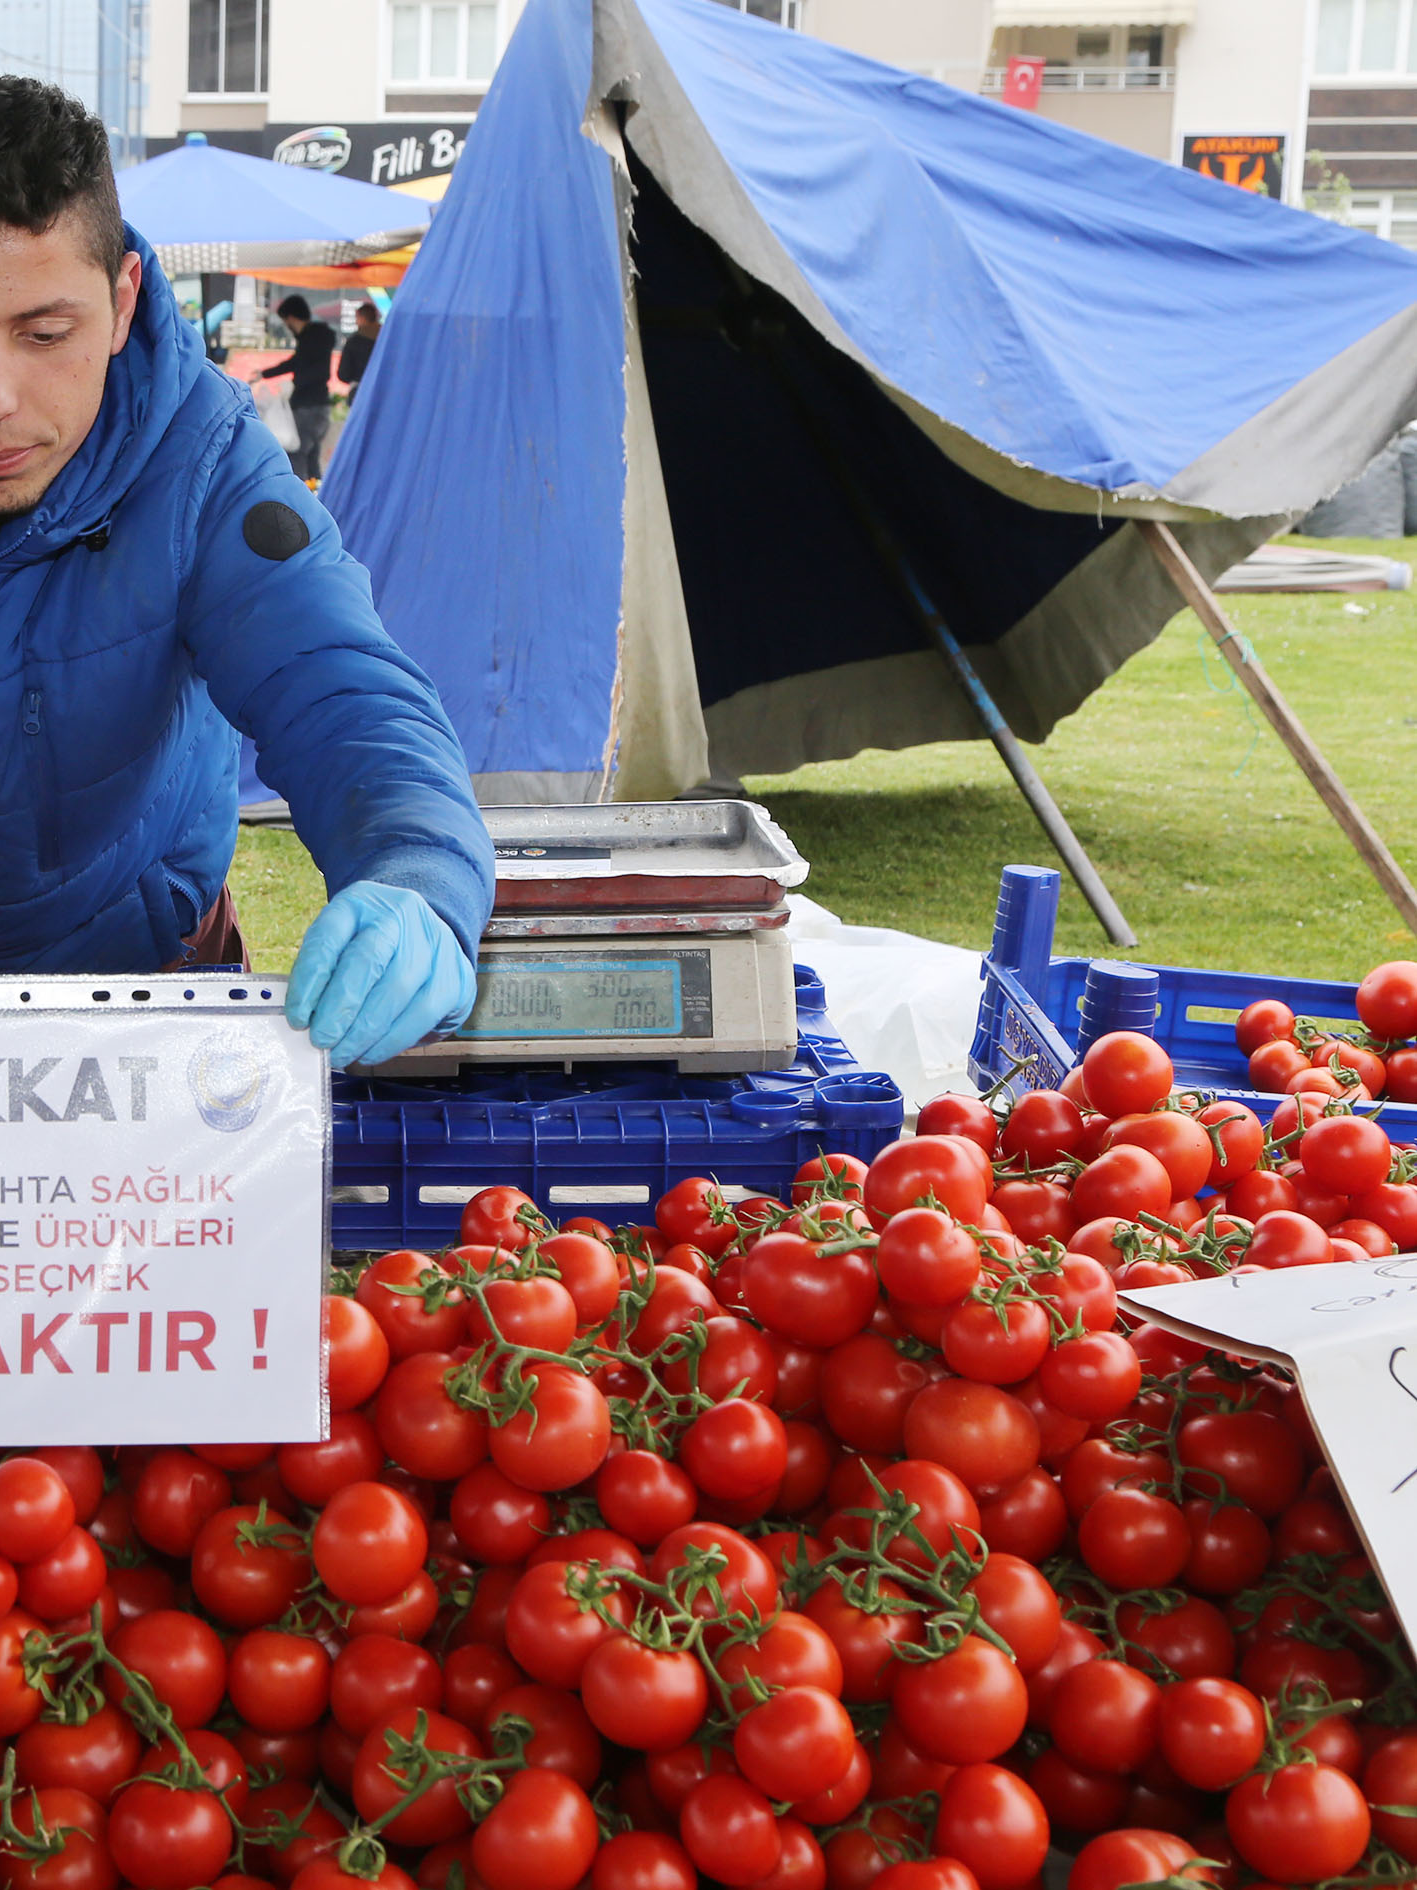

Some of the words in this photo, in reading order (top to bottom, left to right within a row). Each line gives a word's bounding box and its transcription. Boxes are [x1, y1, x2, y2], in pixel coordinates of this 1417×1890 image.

[371, 136, 425, 185] Filli
[1191, 137, 1279, 154] ATAKUM
[90, 1166, 234, 1204] SAĞLIK
[251, 1308, 269, 1371] !
